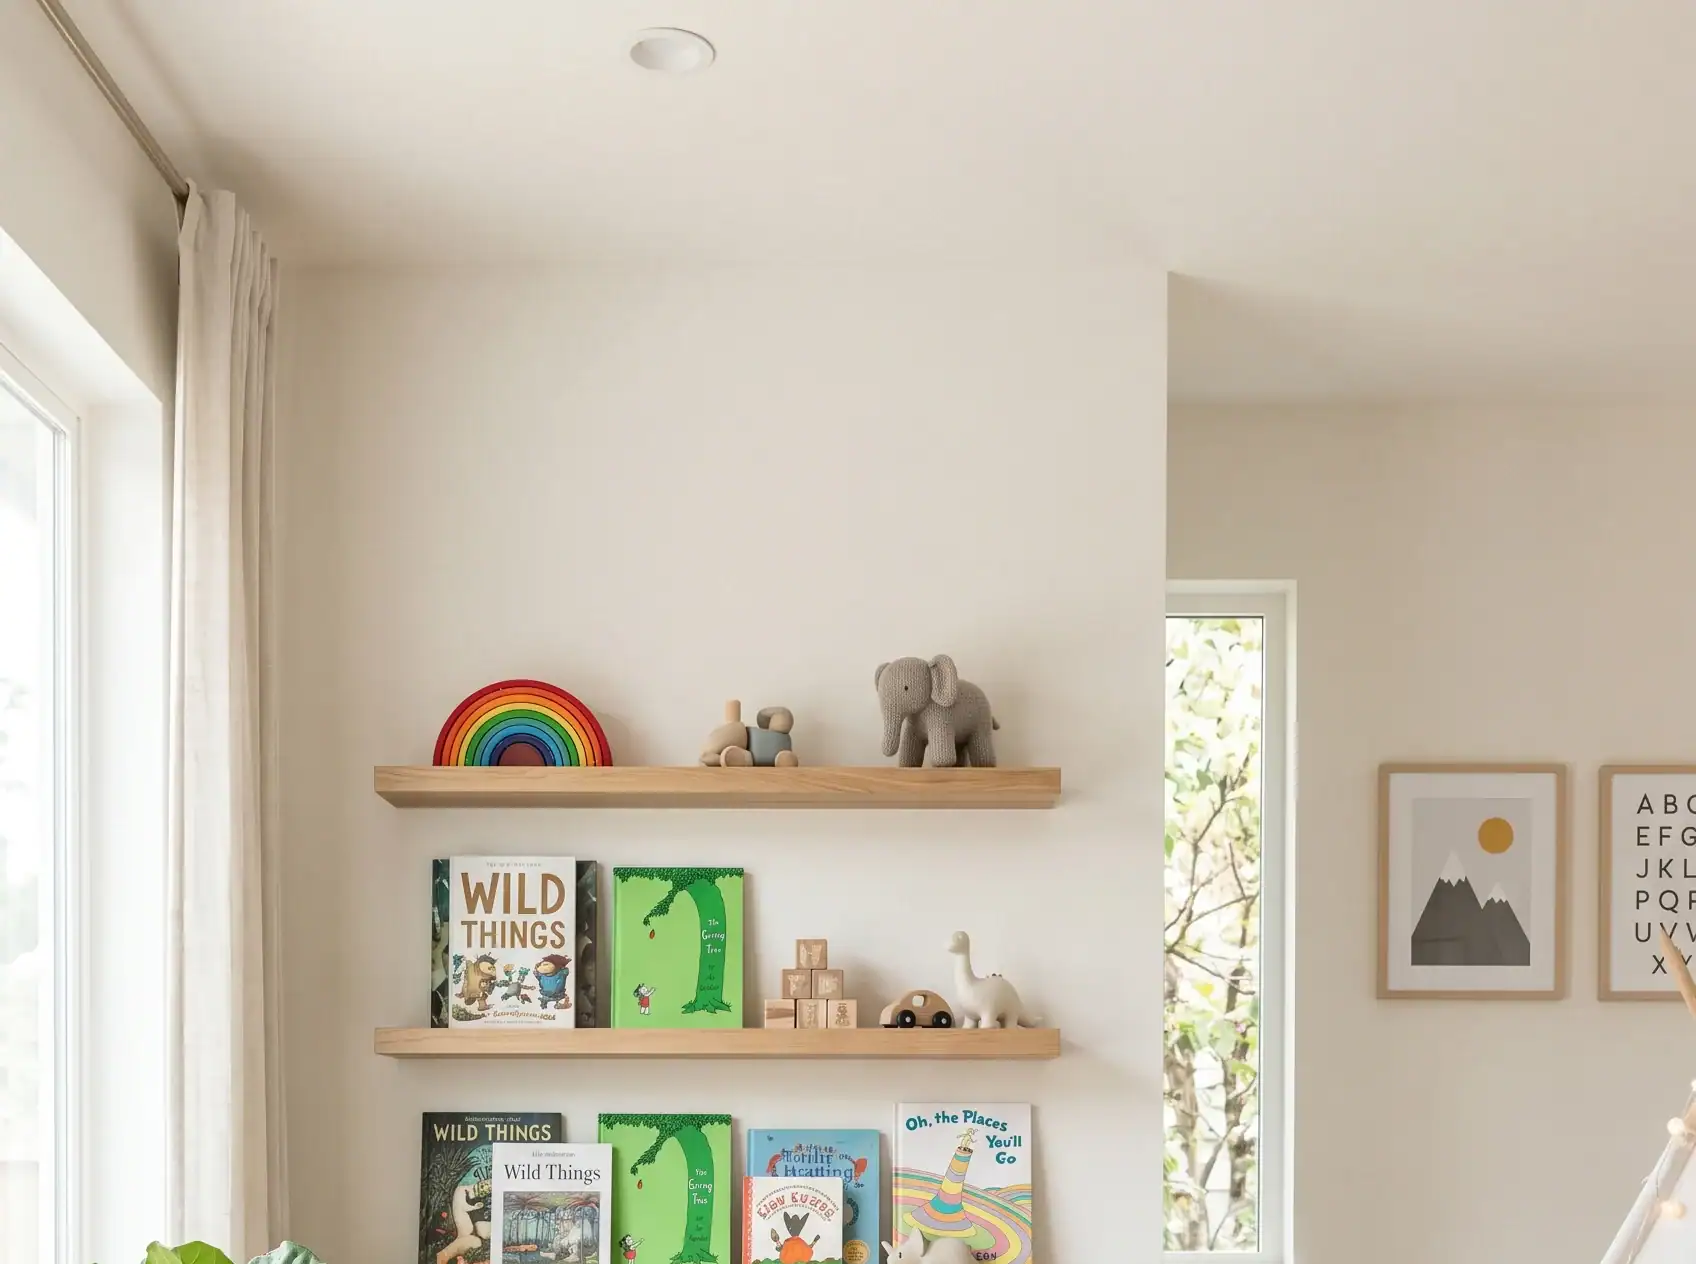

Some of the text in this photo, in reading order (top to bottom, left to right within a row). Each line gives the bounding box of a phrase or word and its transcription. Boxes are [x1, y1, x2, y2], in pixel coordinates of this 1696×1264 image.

[460, 872, 566, 915] WILD
[460, 920, 566, 949] THINGS
[905, 1109, 1008, 1132] Oh, the Places
[433, 1123, 552, 1142] WILD THINGS
[995, 1151, 1017, 1165] Go
[504, 1163, 601, 1186] Wild Things
